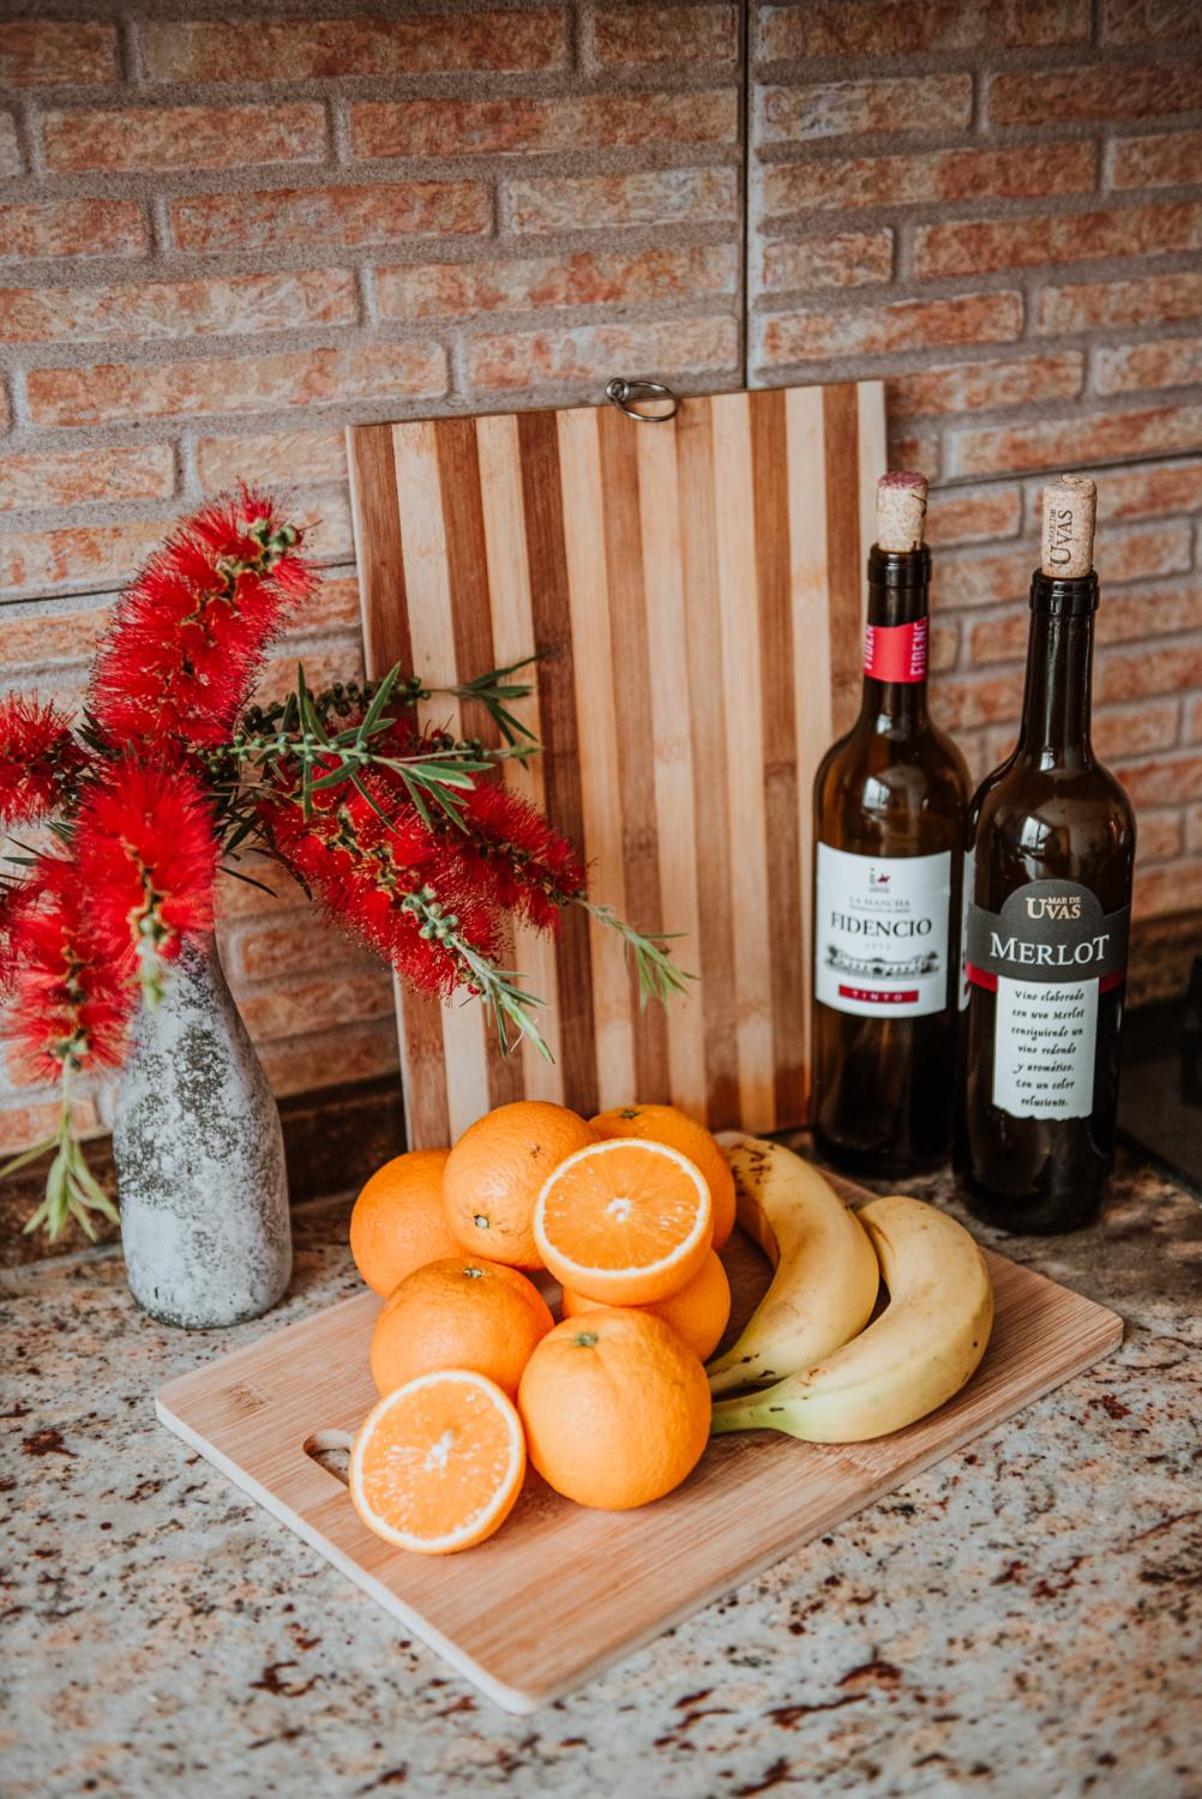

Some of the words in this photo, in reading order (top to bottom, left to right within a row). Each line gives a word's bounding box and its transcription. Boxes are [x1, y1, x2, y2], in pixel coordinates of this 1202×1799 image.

[1048, 509, 1073, 567] UVAS
[864, 897, 911, 907] MANCHA
[1048, 896, 1068, 905] MAR
[1069, 896, 1081, 904] DE
[1025, 897, 1081, 920] UVAS
[831, 911, 933, 937] FIDENCIO
[989, 931, 1110, 966] MERLOT
[851, 990, 903, 1001] TINTO
[1015, 990, 1038, 1000] Vino
[1041, 988, 1084, 1001] elaborado
[1012, 1008, 1027, 1017] con
[1031, 1011, 1048, 1019] uva
[1053, 1006, 1085, 1020] Merlot
[1011, 1025, 1068, 1041] consiguiendo
[1071, 1028, 1083, 1036] un
[1017, 1044, 1038, 1054] vino
[1042, 1042, 1077, 1055] redondo
[1012, 1064, 1024, 1074] y
[1027, 1060, 1074, 1072] aromático.
[1036, 1082, 1049, 1090] un
[1052, 1078, 1075, 1090] color
[1020, 1095, 1069, 1107] reluciente.
